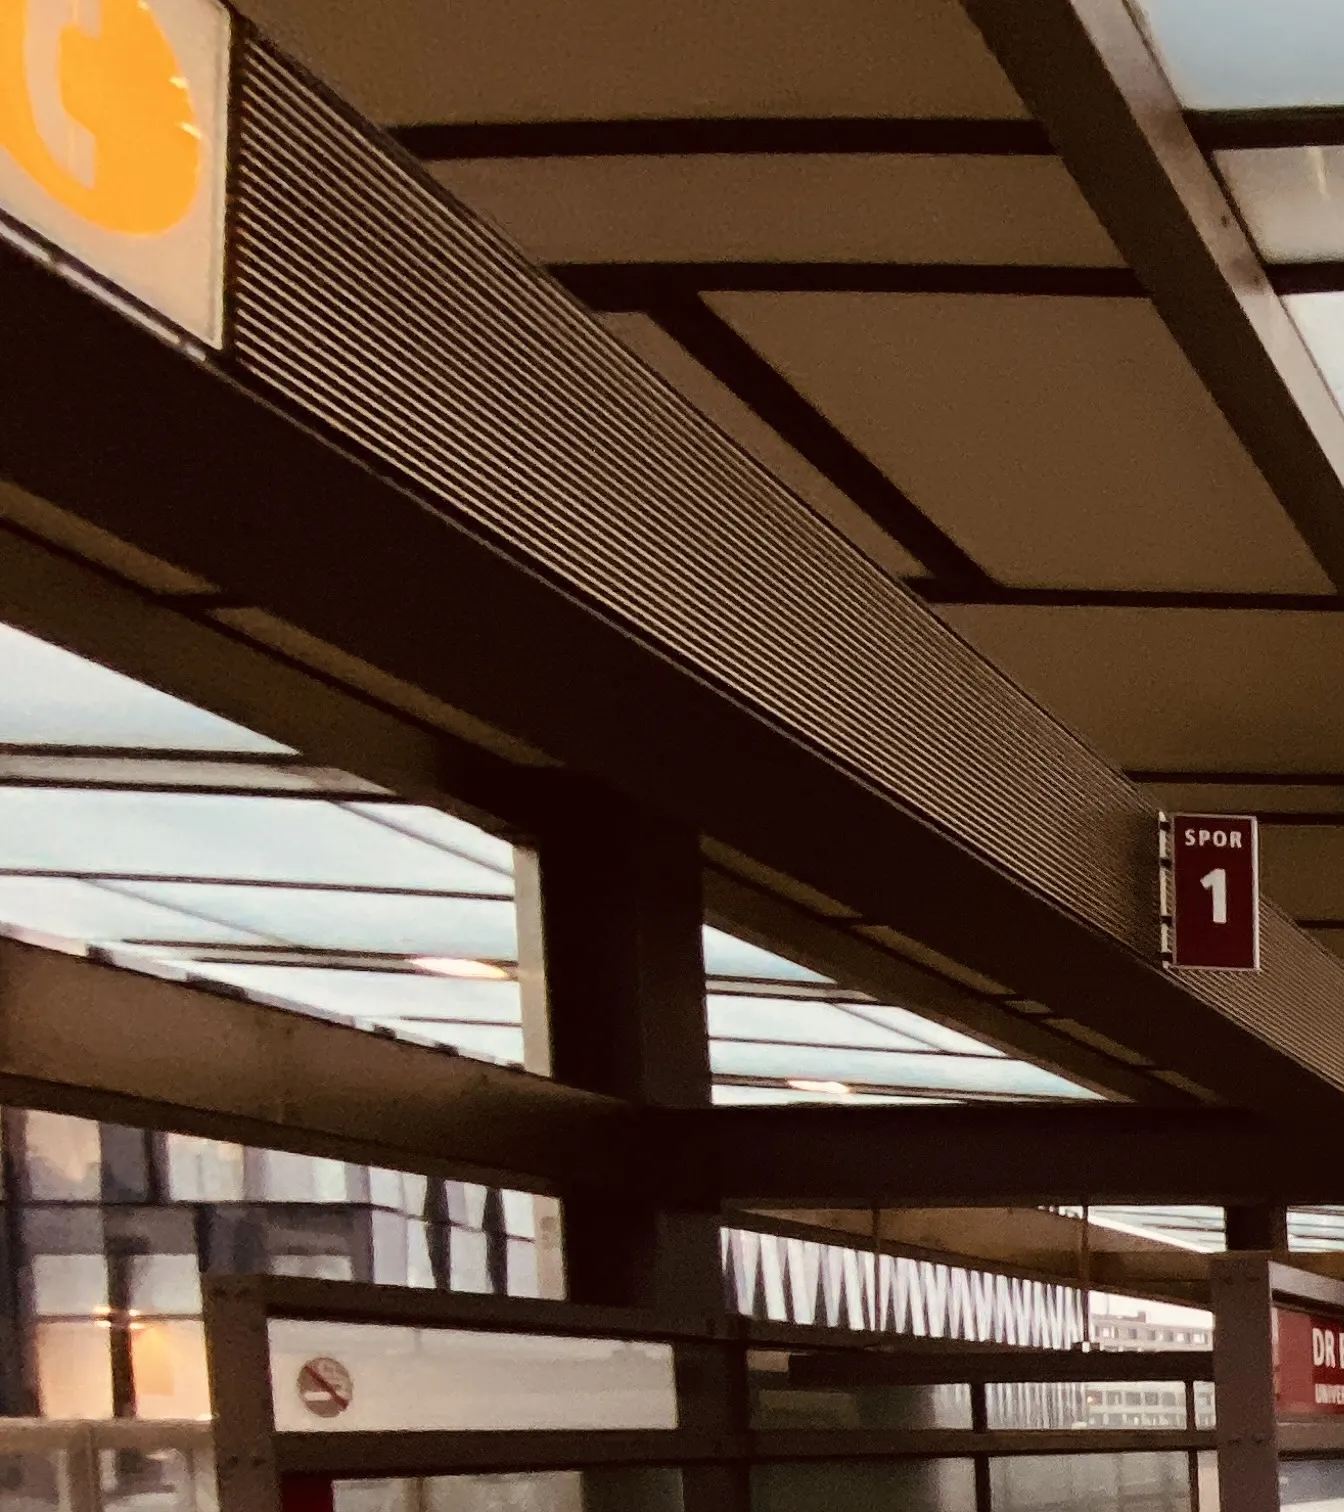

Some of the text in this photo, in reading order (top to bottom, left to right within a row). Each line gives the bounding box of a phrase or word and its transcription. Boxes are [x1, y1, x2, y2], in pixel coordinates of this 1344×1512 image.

[1184, 829, 1242, 848] SPOR
[1200, 868, 1227, 924] 1
[1312, 1328, 1335, 1368] DR
